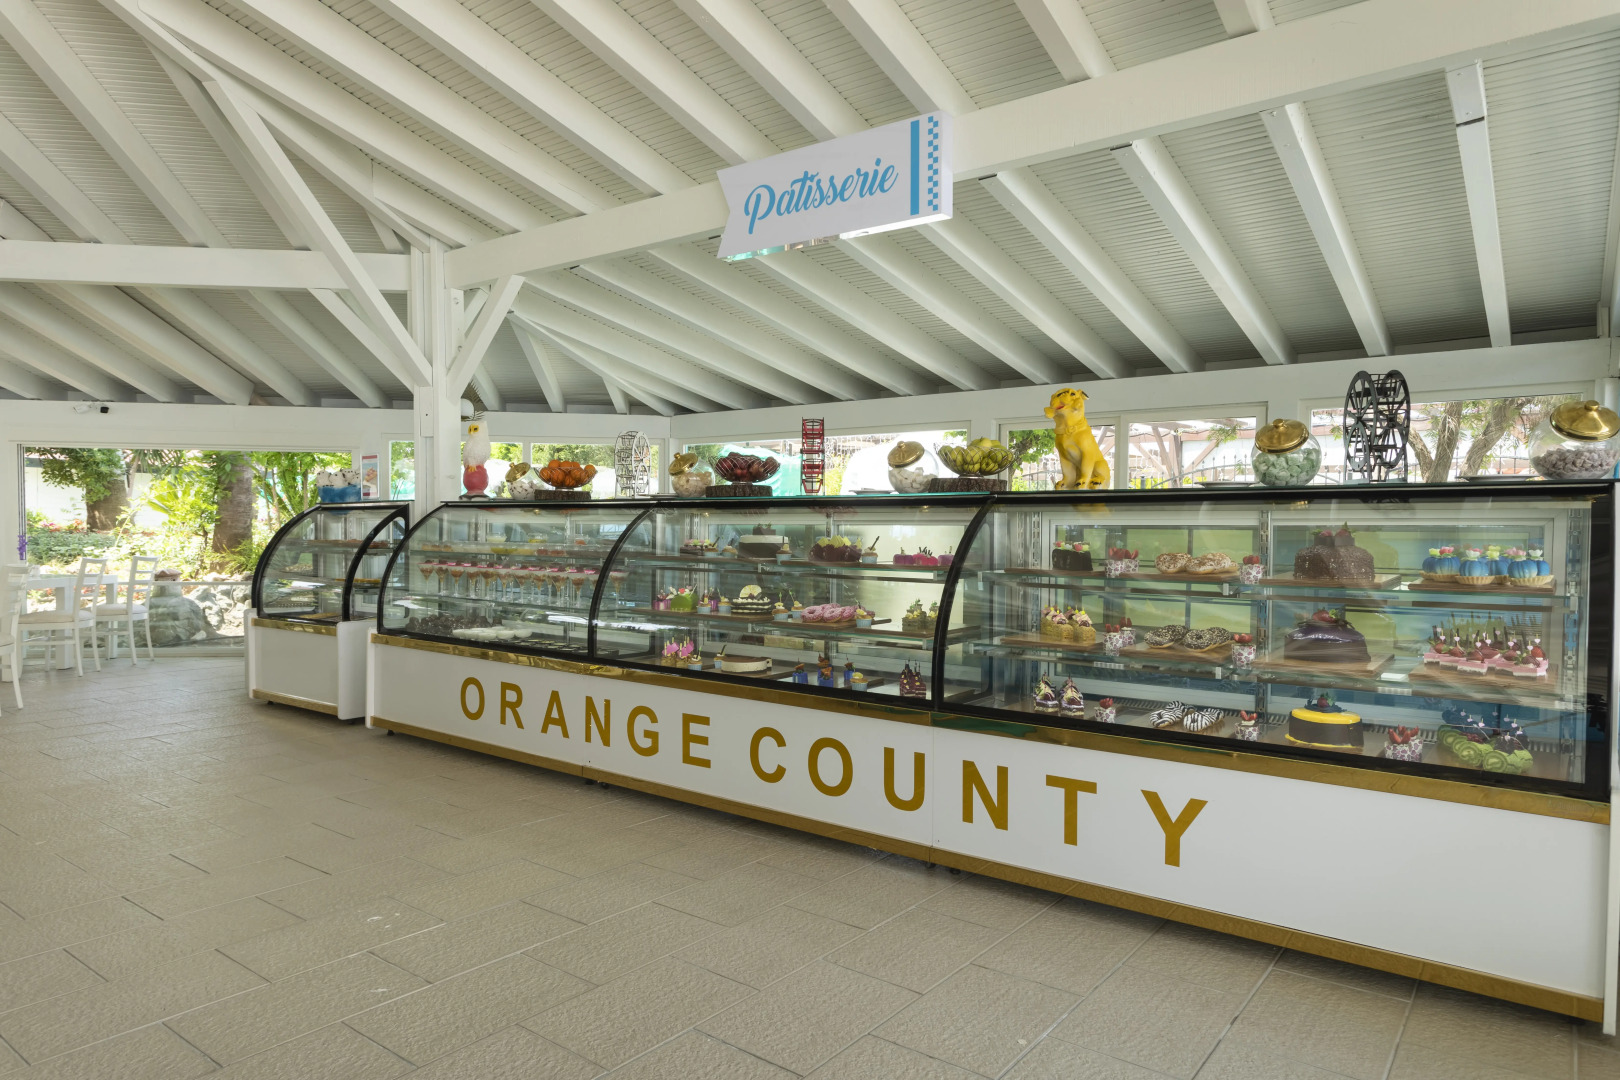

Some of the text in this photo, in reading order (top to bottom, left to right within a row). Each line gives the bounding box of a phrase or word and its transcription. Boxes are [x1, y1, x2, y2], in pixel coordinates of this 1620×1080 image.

[743, 157, 898, 235] Patisserie
[460, 676, 1208, 868] ORANGE COUNTY
